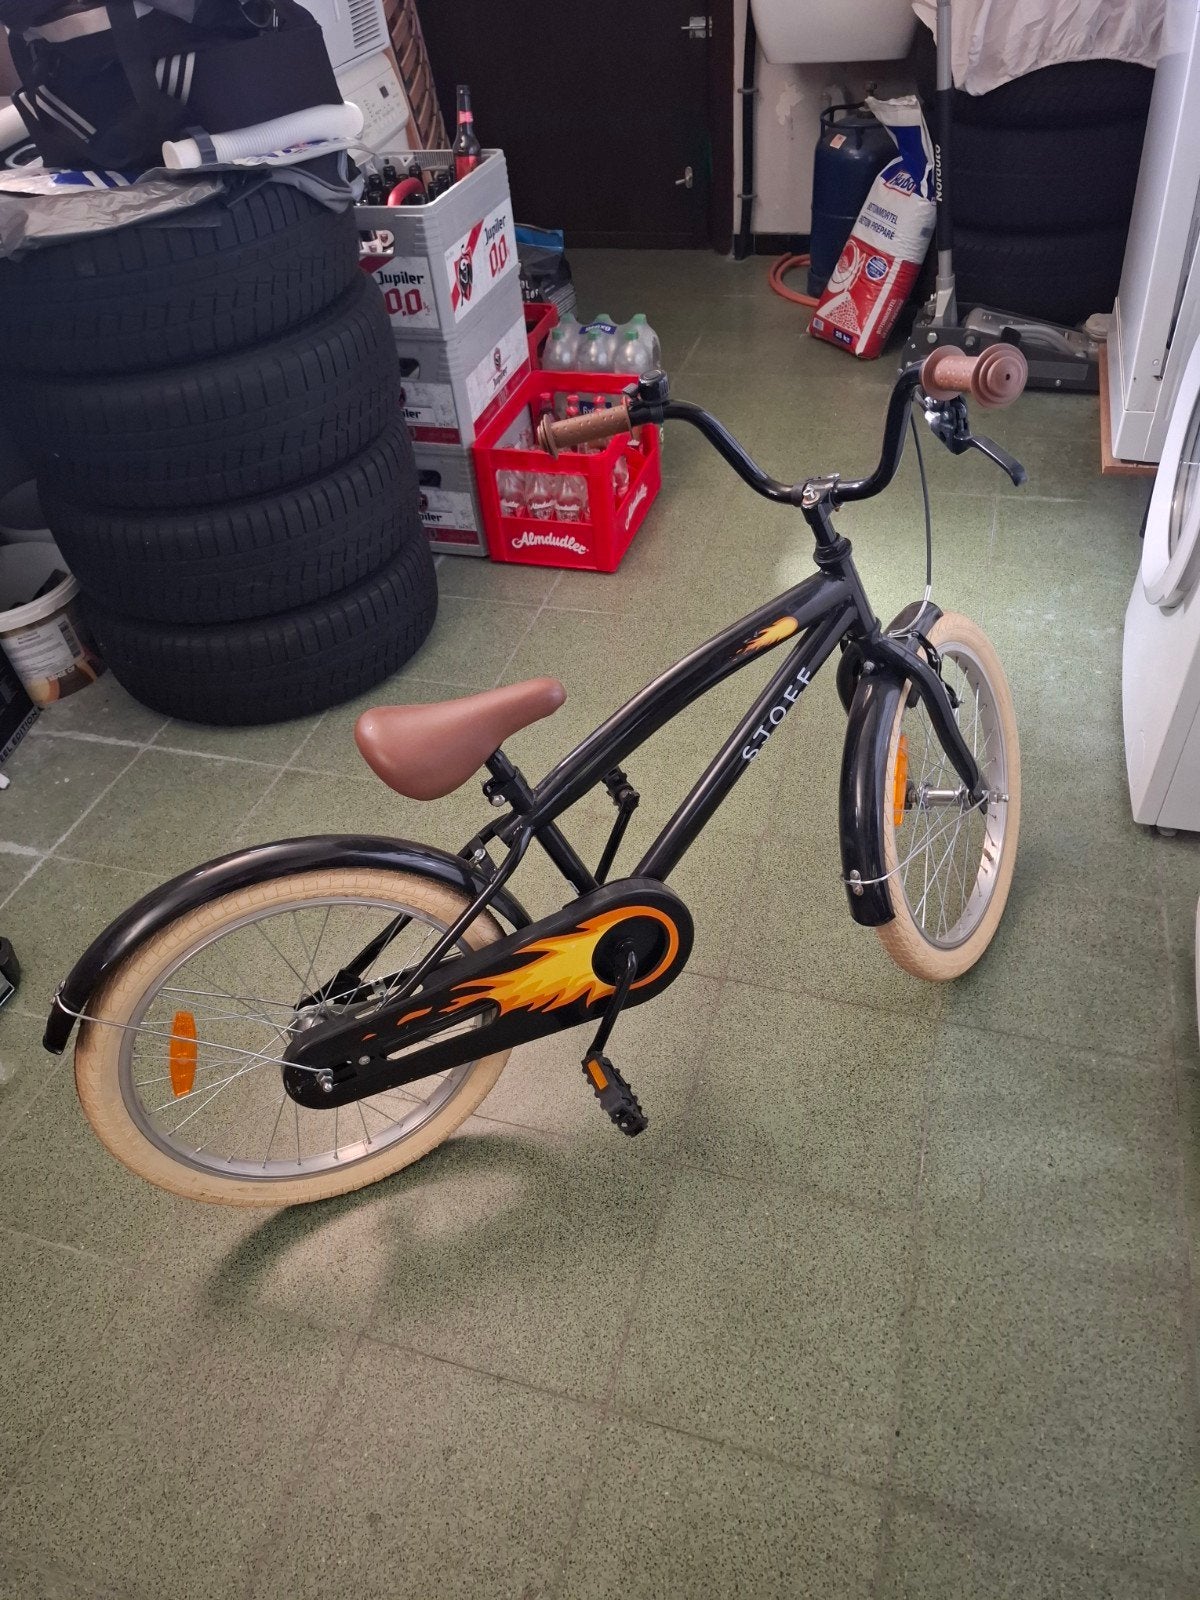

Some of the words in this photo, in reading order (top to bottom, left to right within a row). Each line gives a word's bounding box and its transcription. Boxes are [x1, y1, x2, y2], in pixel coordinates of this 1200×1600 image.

[934, 144, 943, 202] Norauto
[484, 215, 506, 246] Jupiler
[377, 271, 424, 286] Jupiler
[511, 531, 589, 555] Almdudler
[12, 710, 38, 746] EDITION
